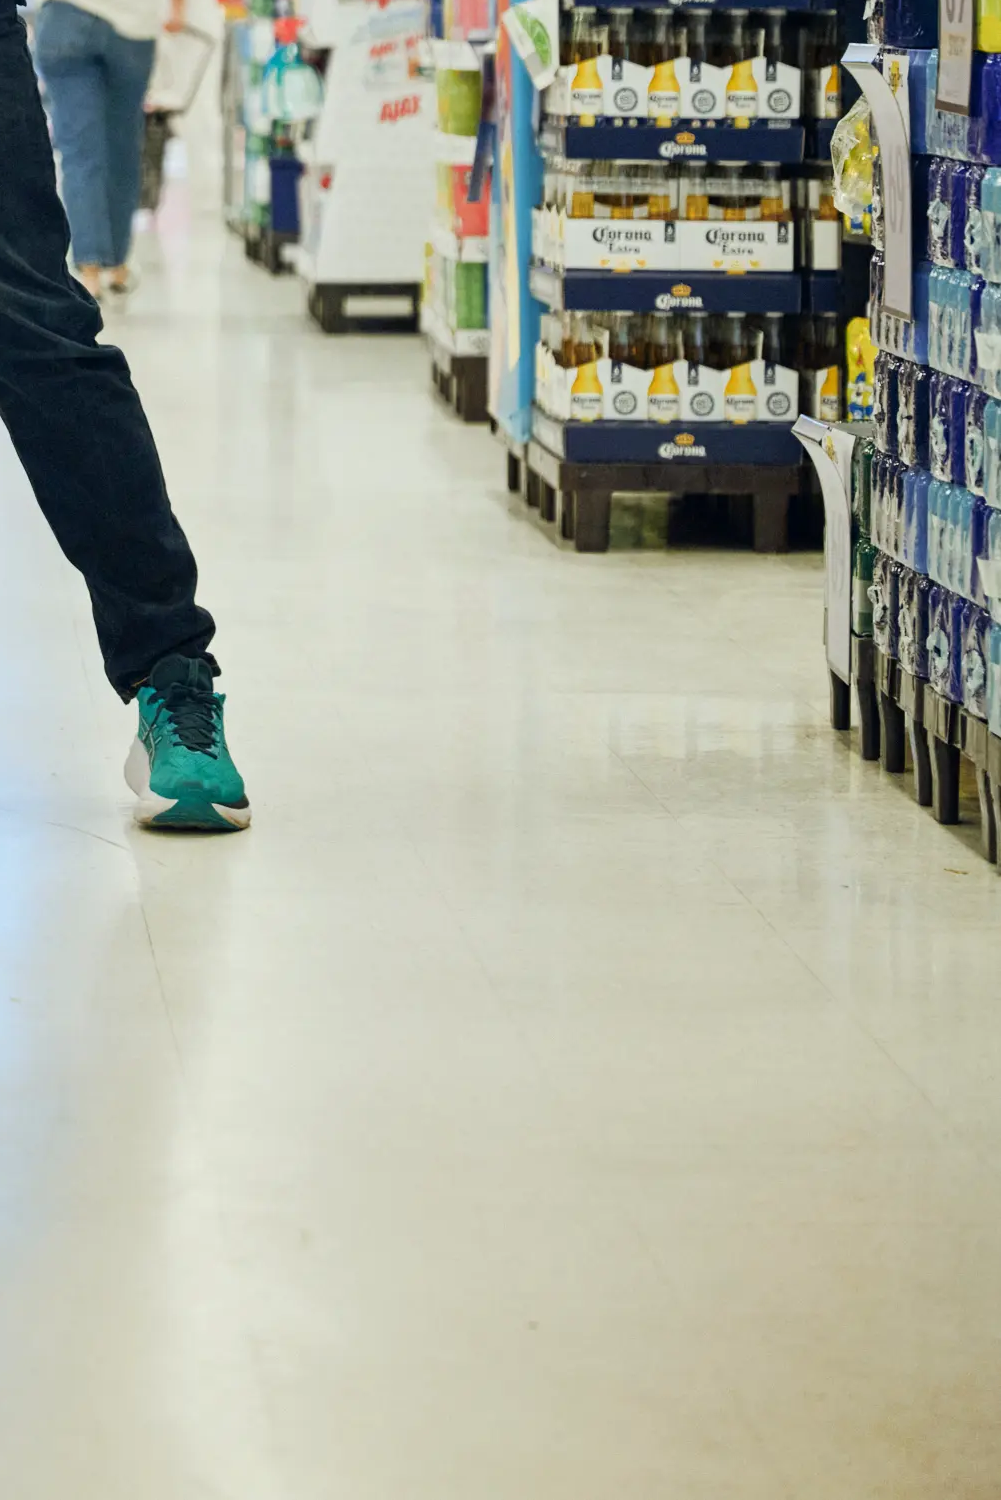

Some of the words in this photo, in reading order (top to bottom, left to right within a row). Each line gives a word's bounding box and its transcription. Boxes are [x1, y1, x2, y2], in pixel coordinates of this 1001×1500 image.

[658, 140, 707, 158] Corona
[592, 225, 652, 246] Corona
[705, 227, 766, 247] Corona
[655, 292, 703, 310] Corona
[657, 441, 707, 459] Corona
